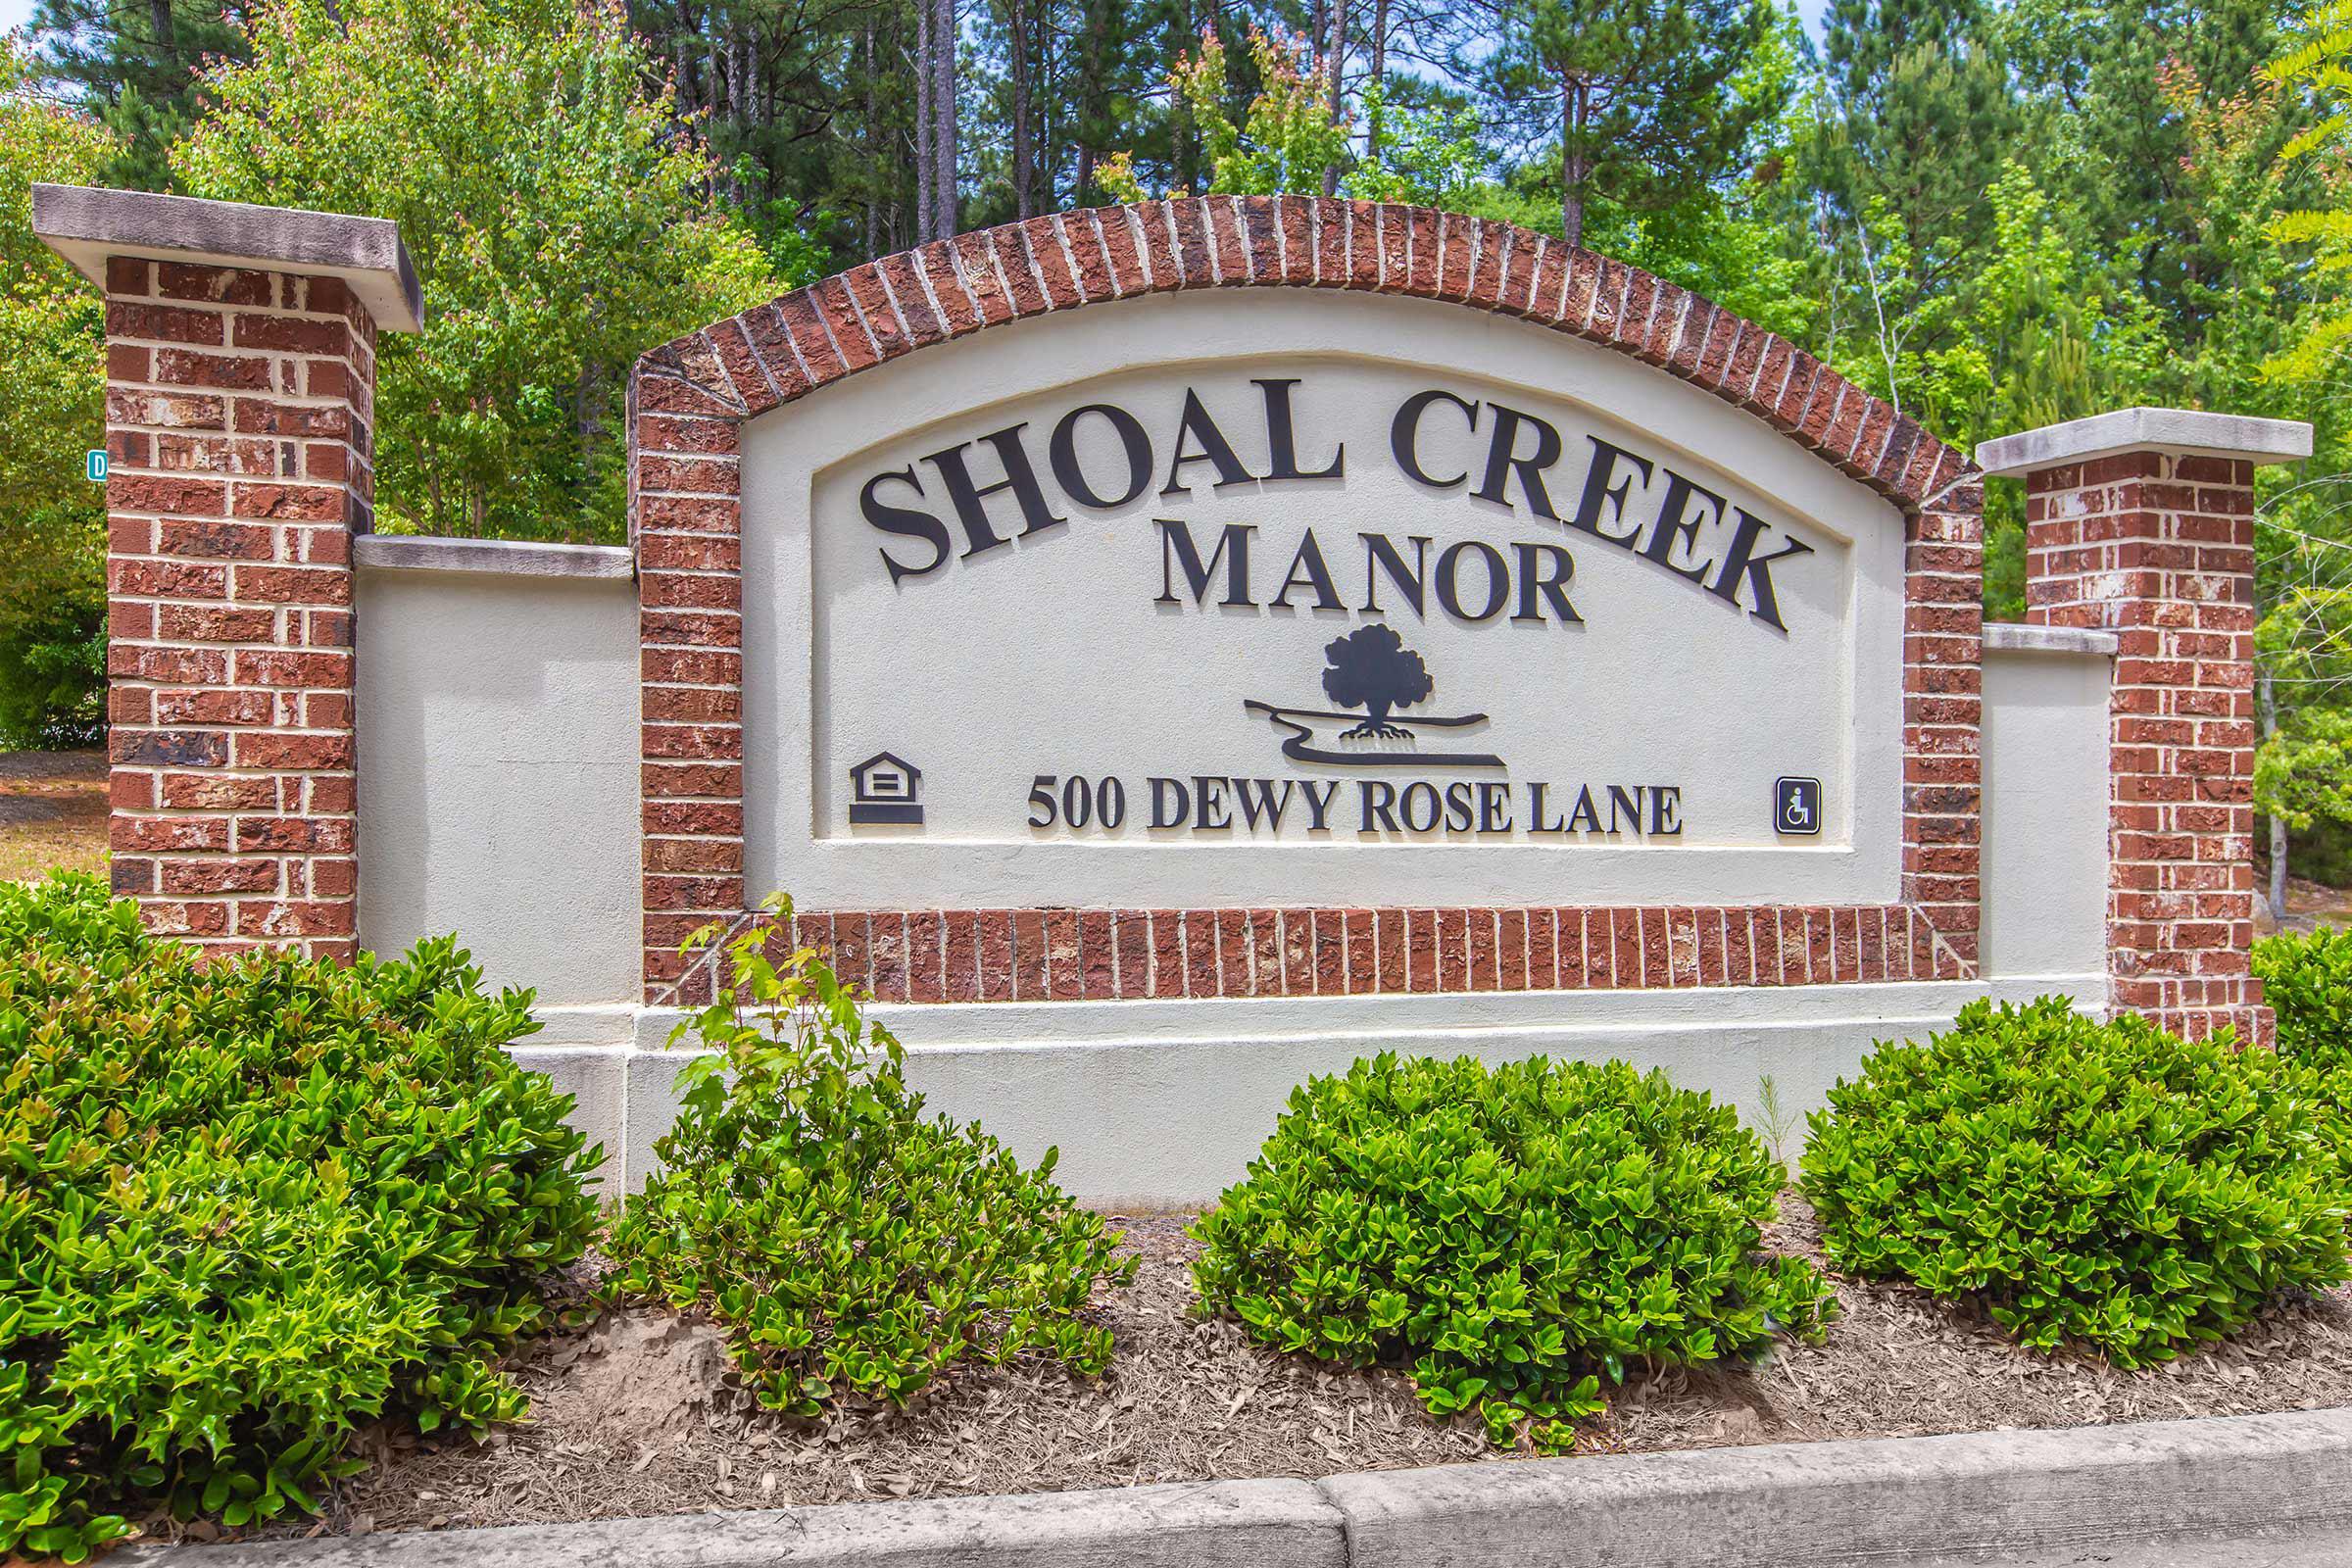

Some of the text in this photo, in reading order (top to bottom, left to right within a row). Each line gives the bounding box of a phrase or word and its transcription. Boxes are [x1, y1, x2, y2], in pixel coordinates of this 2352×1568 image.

[859, 378, 1815, 635] SHOAL CREEK
[1152, 518, 1585, 626] MANOR
[1027, 774, 1684, 836] 500 DEWY ROSE LANE
